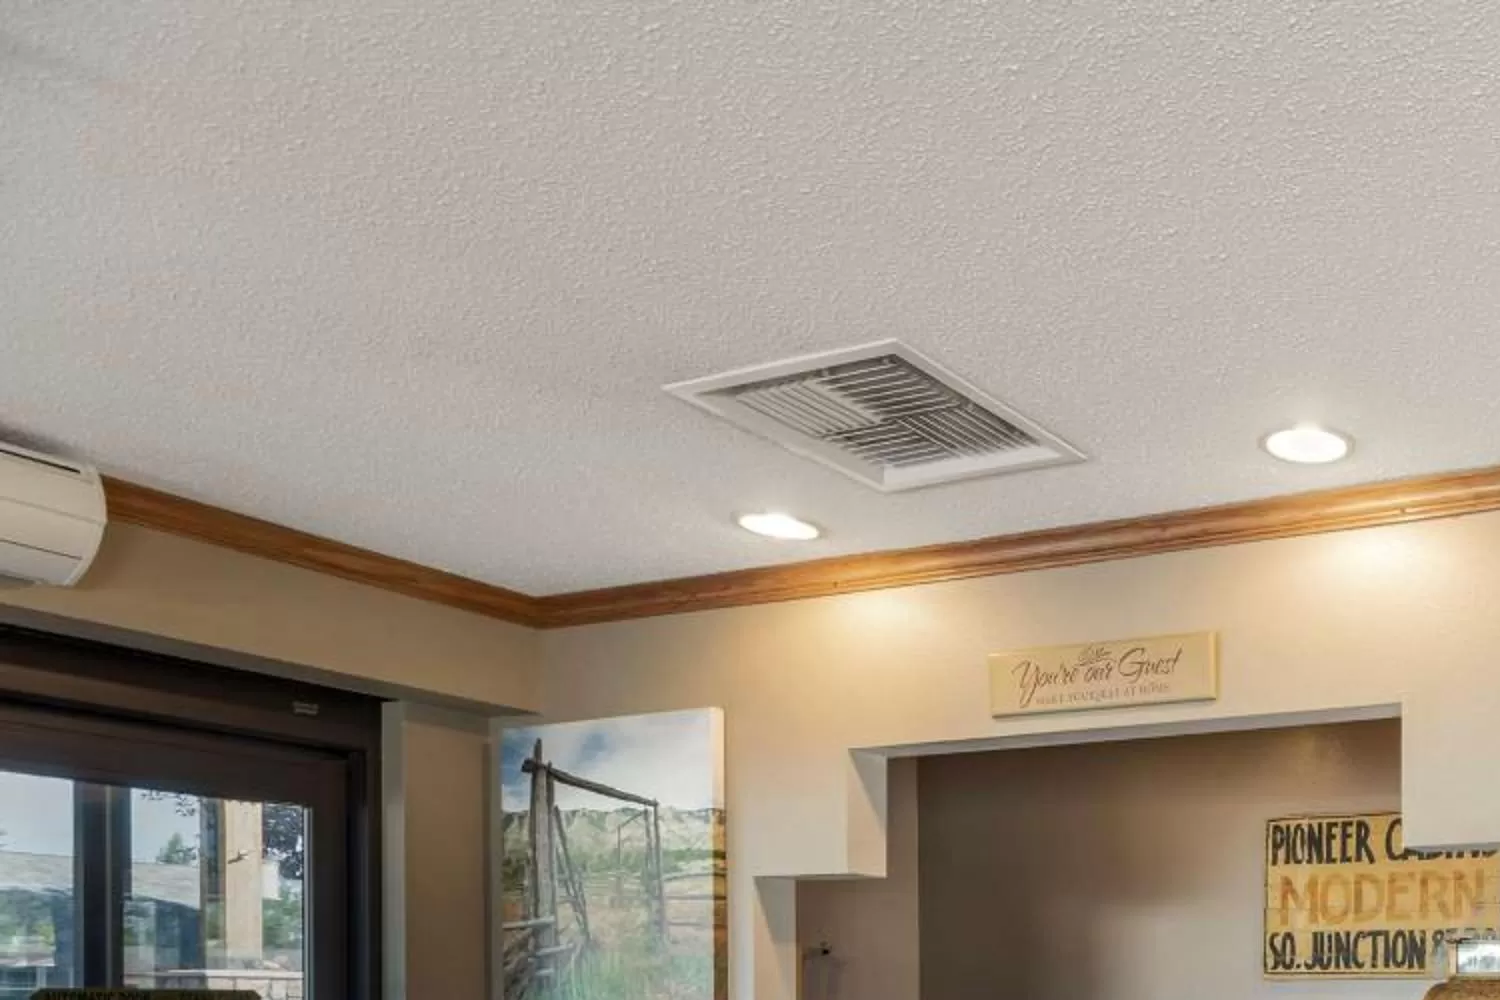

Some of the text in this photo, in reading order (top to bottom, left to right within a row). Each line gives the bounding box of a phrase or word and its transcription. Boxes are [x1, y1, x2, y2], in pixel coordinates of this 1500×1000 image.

[1010, 659, 1077, 708] You're
[1083, 665, 1113, 683] our
[1118, 646, 1182, 685] Guest
[1270, 819, 1375, 867] PIONEER
[1279, 868, 1485, 927] MODERN
[1304, 929, 1427, 971] JUNCTION
